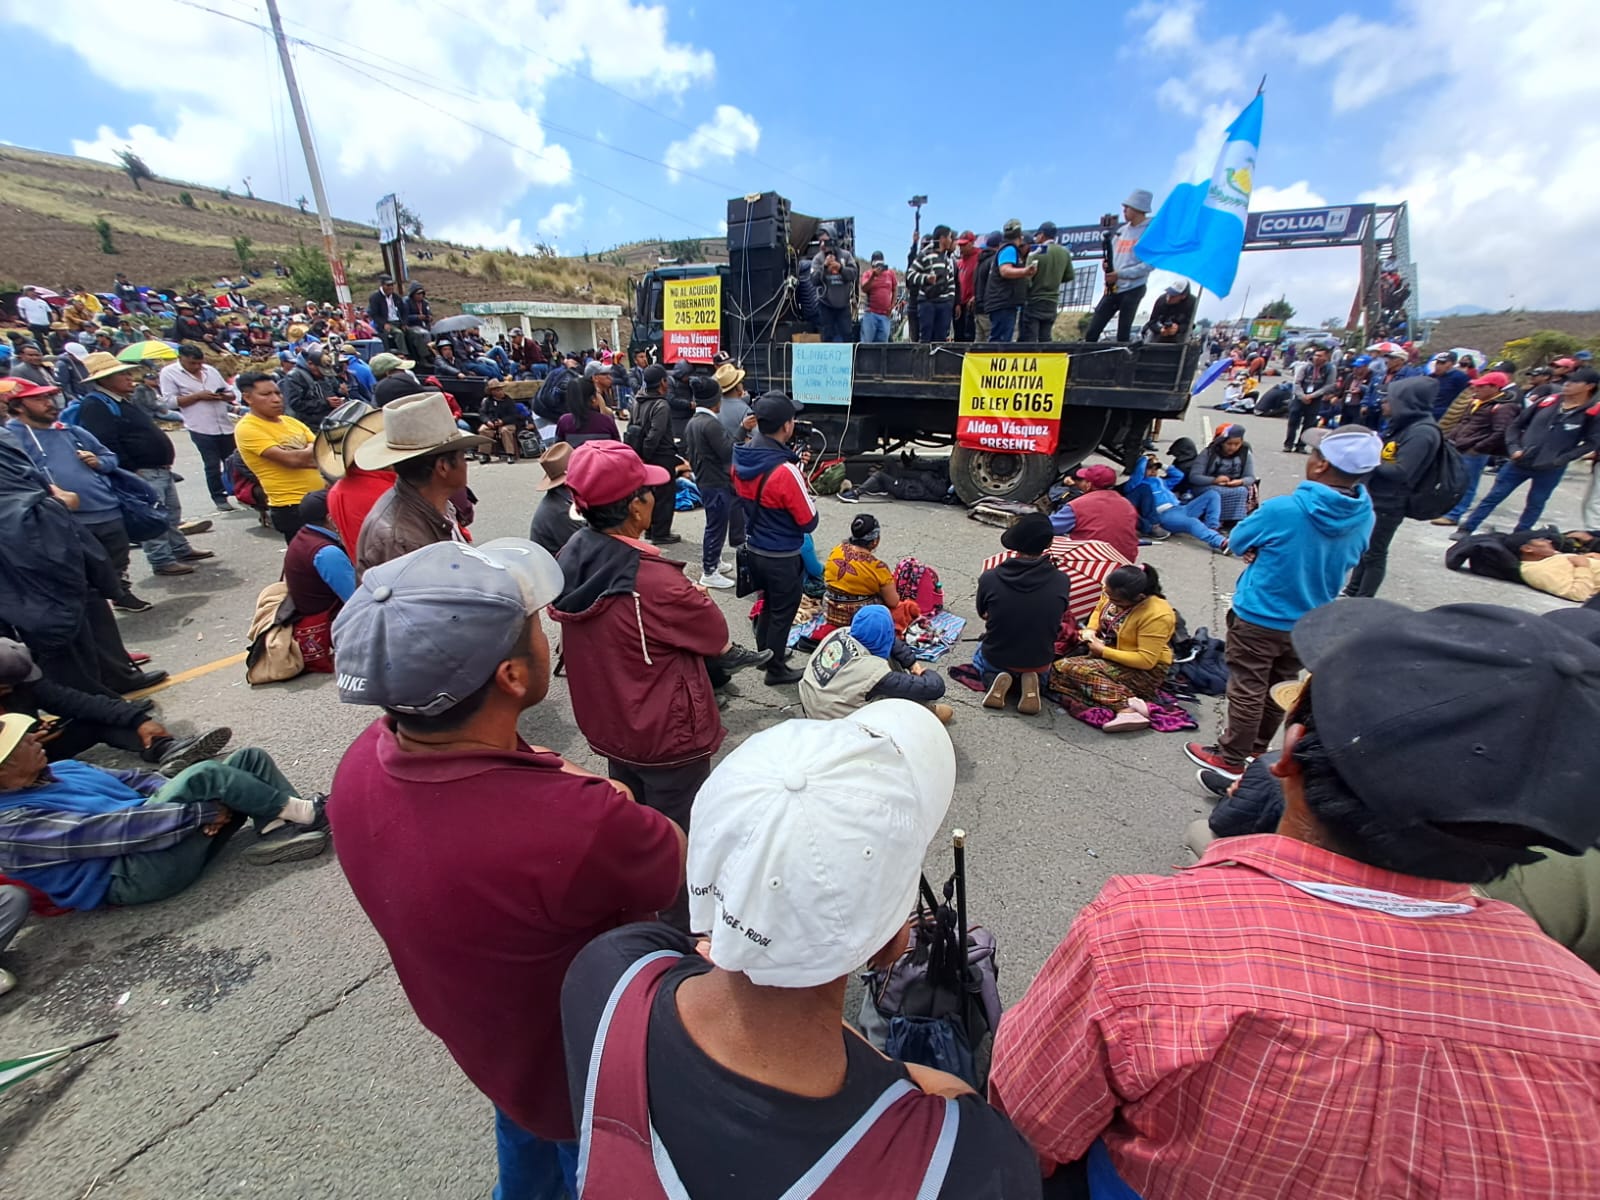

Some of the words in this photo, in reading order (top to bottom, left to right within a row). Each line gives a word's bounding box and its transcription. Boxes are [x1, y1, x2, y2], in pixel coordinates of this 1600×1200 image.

[1261, 215, 1325, 231] COLUA
[670, 288, 679, 297] NO
[680, 287, 687, 296] AL
[689, 285, 718, 295] ACUERDO
[673, 298, 715, 309] GUBERNATIVO
[675, 310, 716, 324] 245-2022
[670, 333, 690, 344] Aldea
[690, 333, 718, 346] Vásquez
[678, 347, 712, 358] PRESENTE
[990, 358, 1007, 372] NO
[1010, 358, 1018, 372] A
[1023, 358, 1037, 372] LA
[980, 375, 1043, 390] INICIATIVA
[971, 397, 986, 410] DE
[989, 397, 1009, 410] LEY
[1012, 393, 1054, 412] 6165
[966, 420, 998, 434] Aldea
[1001, 420, 1049, 437] Vásquez
[980, 437, 1037, 451] PRESENTE
[336, 673, 368, 692] NIKE
